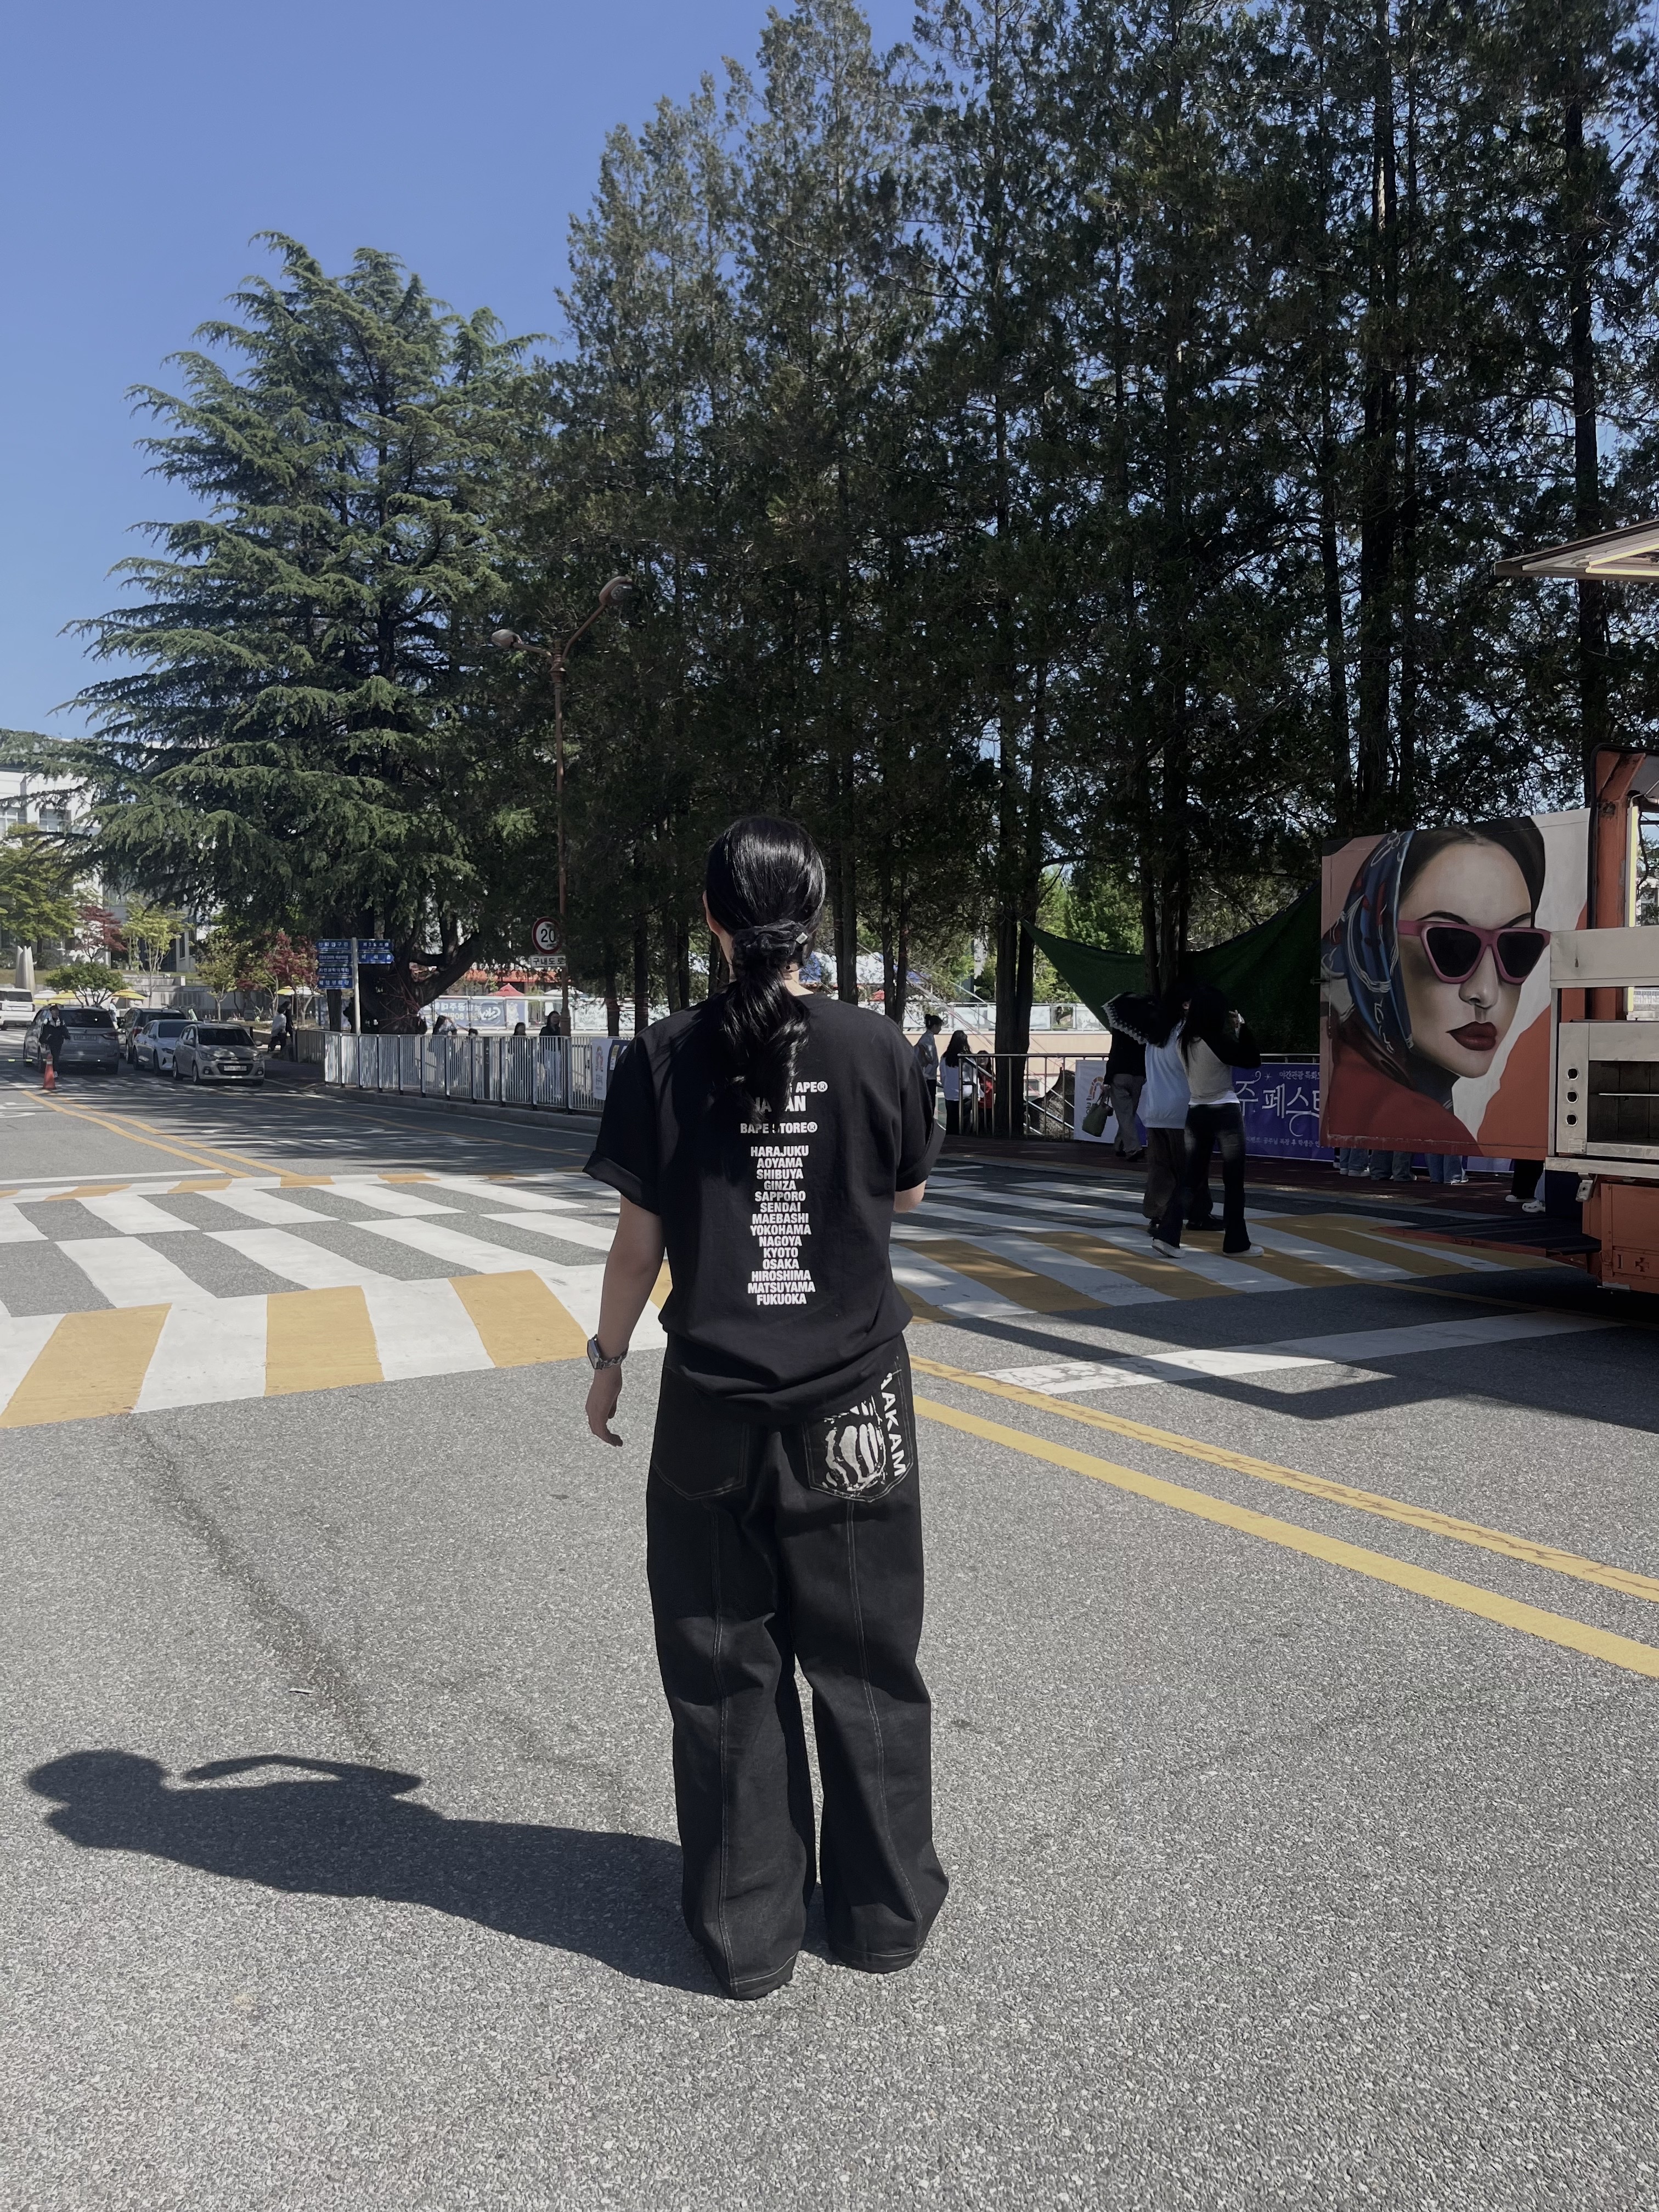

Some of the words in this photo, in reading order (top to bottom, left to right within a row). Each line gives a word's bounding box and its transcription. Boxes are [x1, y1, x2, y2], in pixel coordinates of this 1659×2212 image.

[540, 928, 556, 943] 20
[533, 957, 565, 966] 구내도로
[754, 1096, 806, 1112] JAAN
[741, 1124, 769, 1133] BAPE
[751, 1145, 809, 1156] HARAJUKU
[757, 1157, 803, 1168] AOYAMA
[756, 1169, 804, 1180] SHIBUYA
[764, 1180, 797, 1190] GINZA
[754, 1191, 806, 1201] SAPPORO
[760, 1202, 801, 1212] SENDAI
[752, 1213, 809, 1224] MAEBASHI
[749, 1224, 812, 1235] YOKOHAMA
[759, 1235, 803, 1246] NAGOYA
[763, 1247, 799, 1258] KYOTO
[762, 1259, 800, 1269] OSAKA
[751, 1270, 811, 1281] HIROSHIMA
[747, 1282, 816, 1293] MATSUYAMA
[756, 1294, 807, 1305] FUKUOKA
